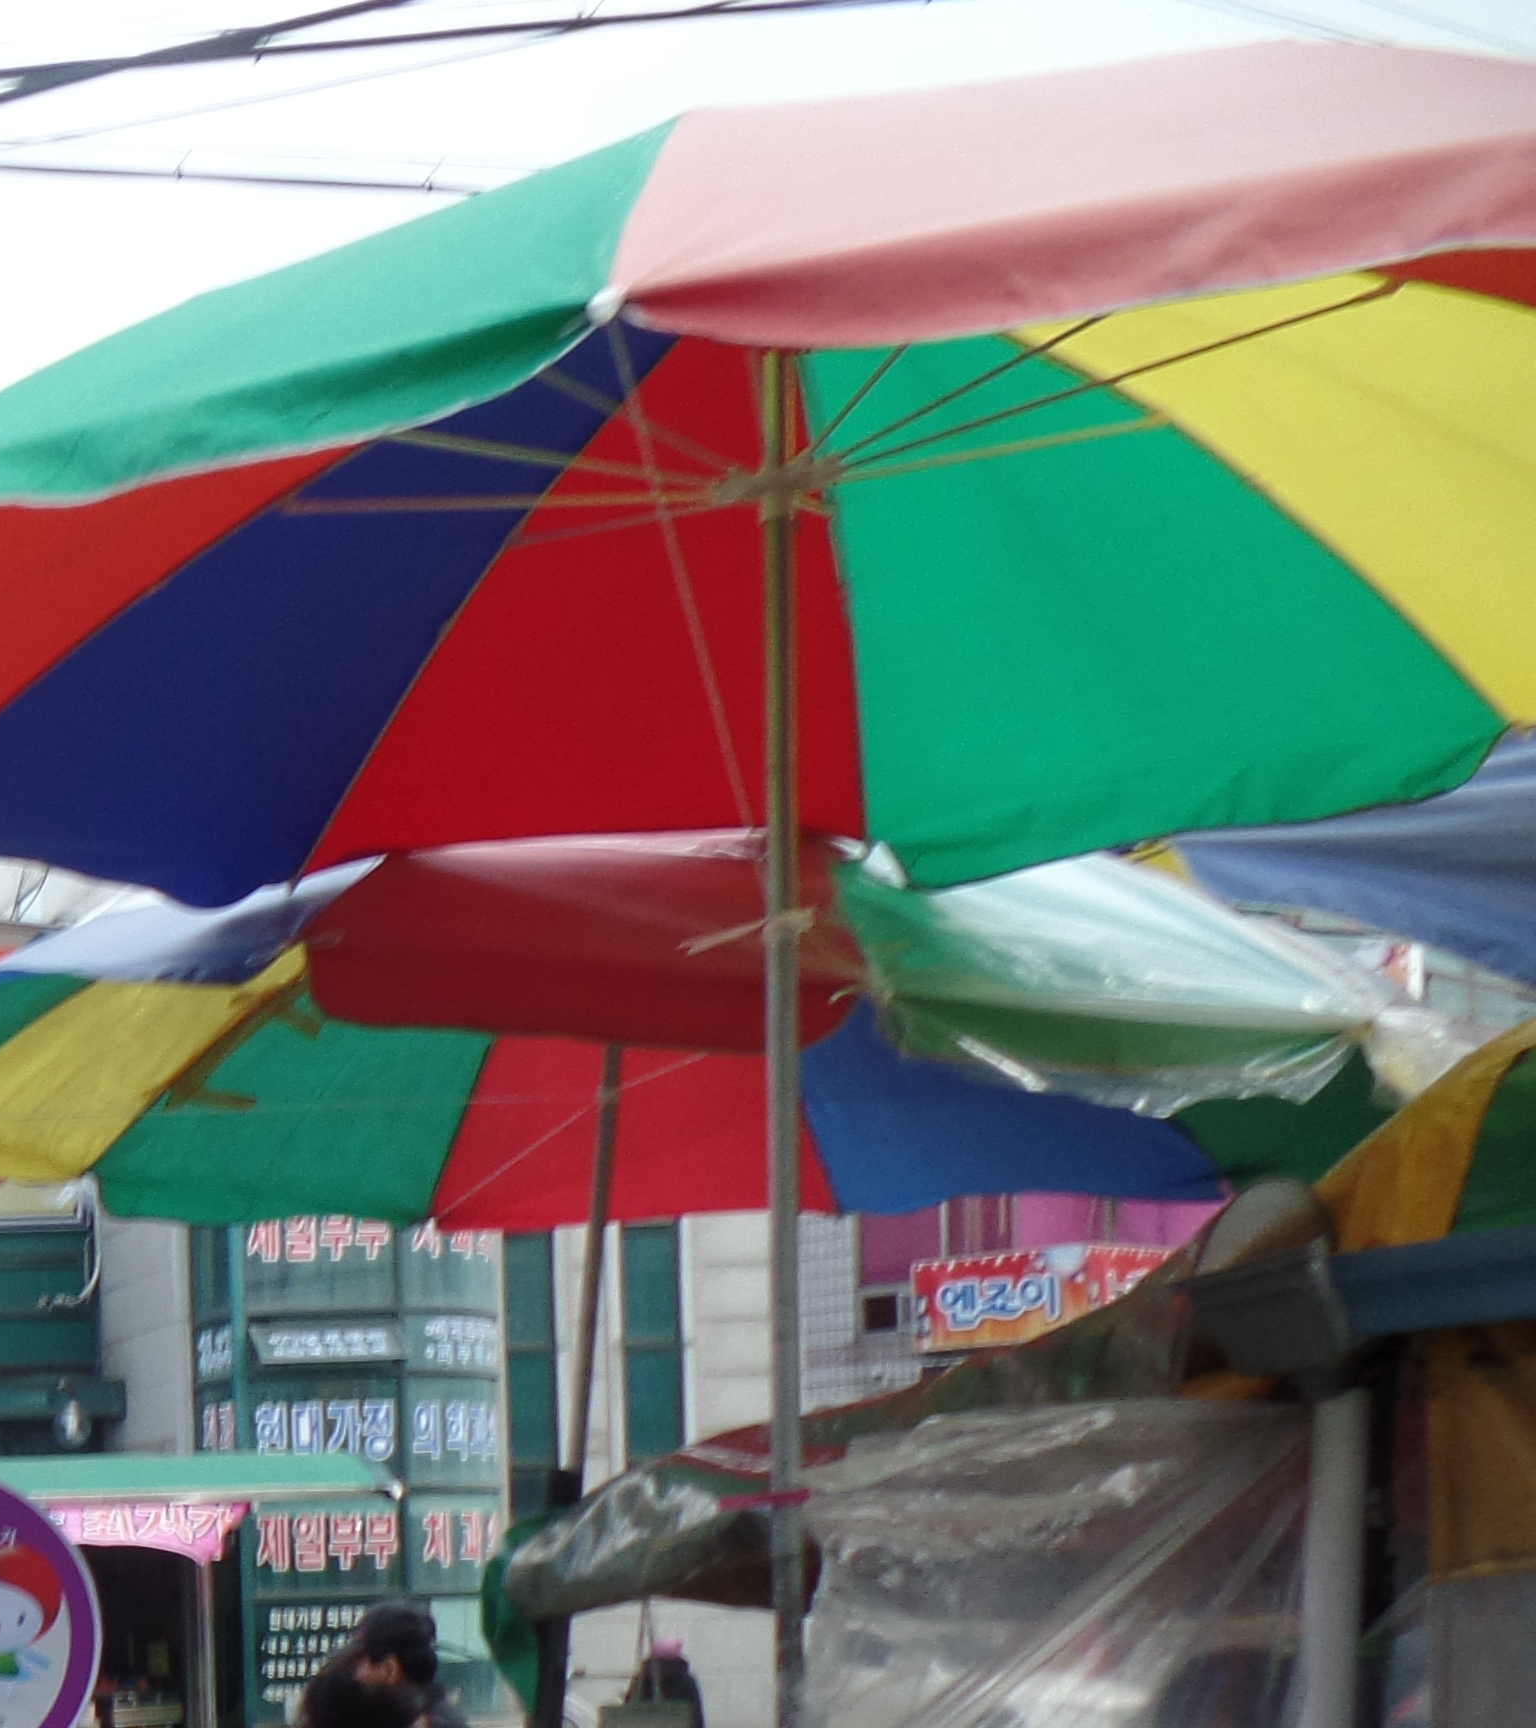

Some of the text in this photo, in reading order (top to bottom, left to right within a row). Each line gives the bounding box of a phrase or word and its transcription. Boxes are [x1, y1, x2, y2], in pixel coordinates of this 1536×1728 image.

[937, 1272, 1061, 1332] 엔조이
[255, 1400, 395, 1462] 현대가정
[255, 1511, 399, 1572] 제일부부
